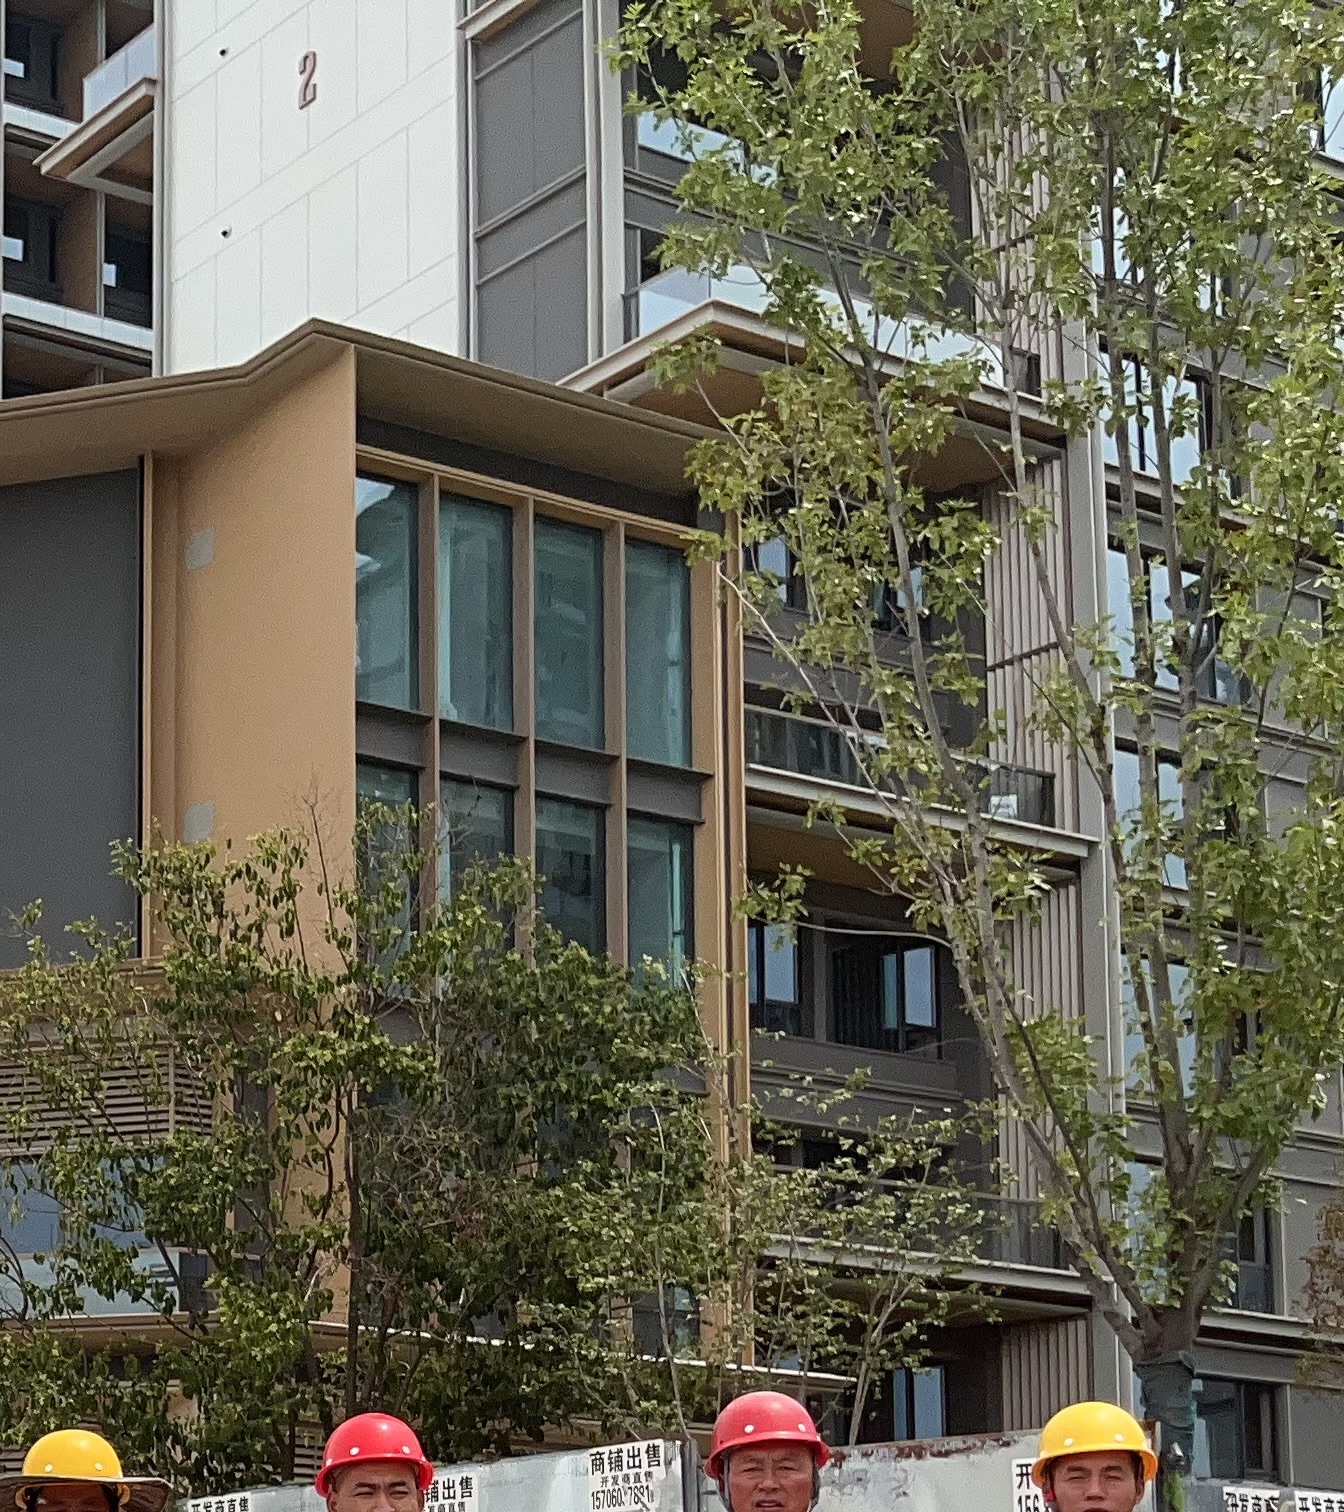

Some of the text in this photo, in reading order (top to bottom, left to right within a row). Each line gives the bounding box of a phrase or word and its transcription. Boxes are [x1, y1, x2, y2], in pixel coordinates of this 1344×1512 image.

[298, 50, 317, 111] 2
[589, 1442, 661, 1476] 商铺出售
